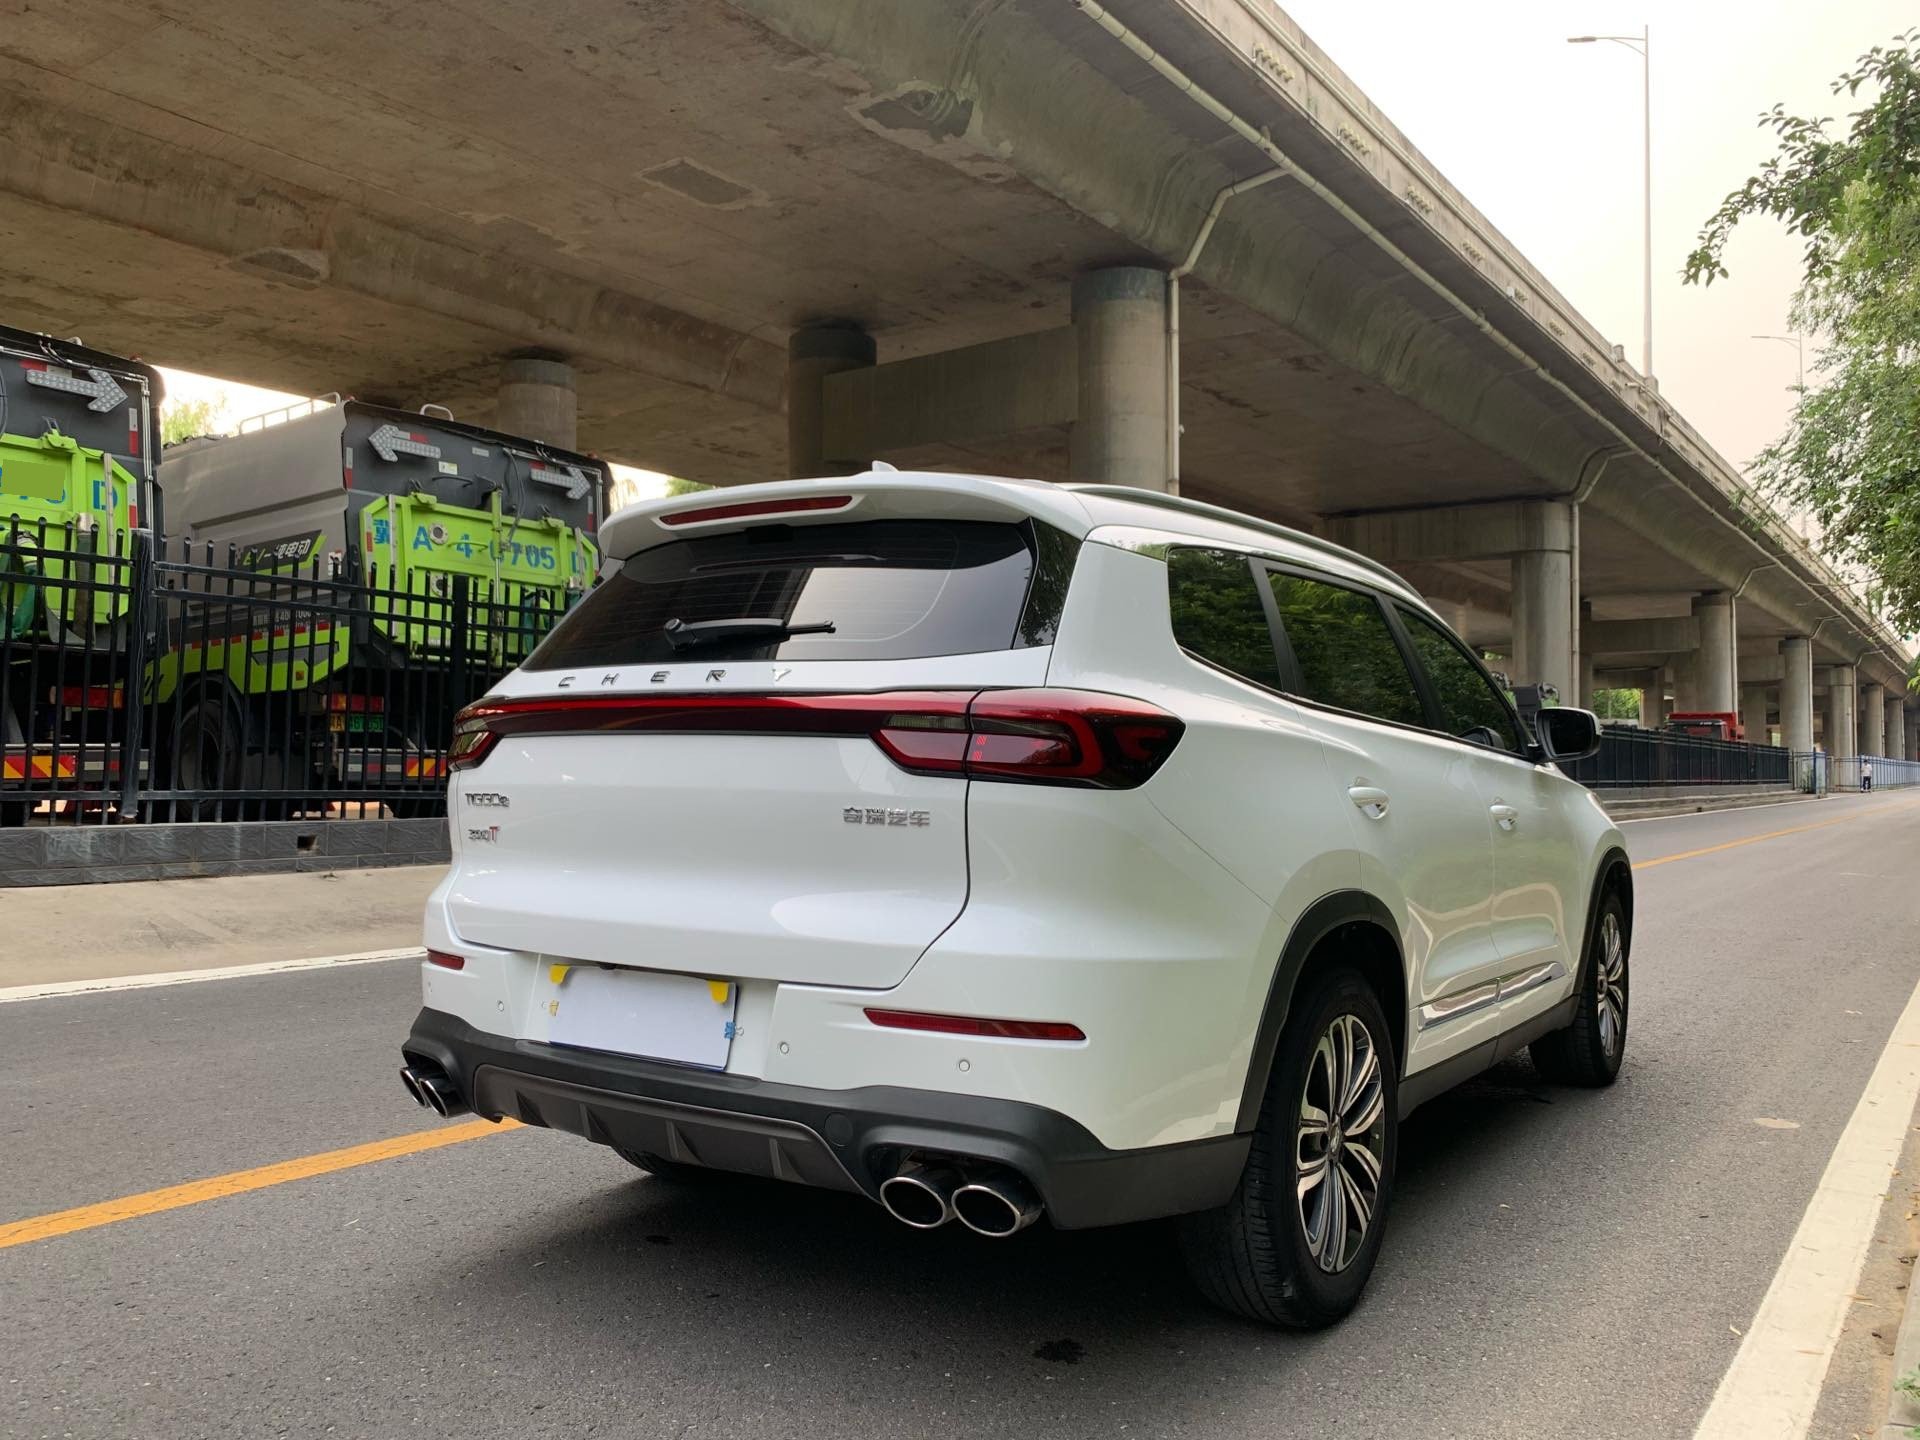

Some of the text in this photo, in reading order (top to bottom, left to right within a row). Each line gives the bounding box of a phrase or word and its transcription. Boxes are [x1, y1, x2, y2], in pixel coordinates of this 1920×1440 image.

[558, 668, 792, 688] CHERY
[842, 807, 930, 828] 奇瑞汽车
